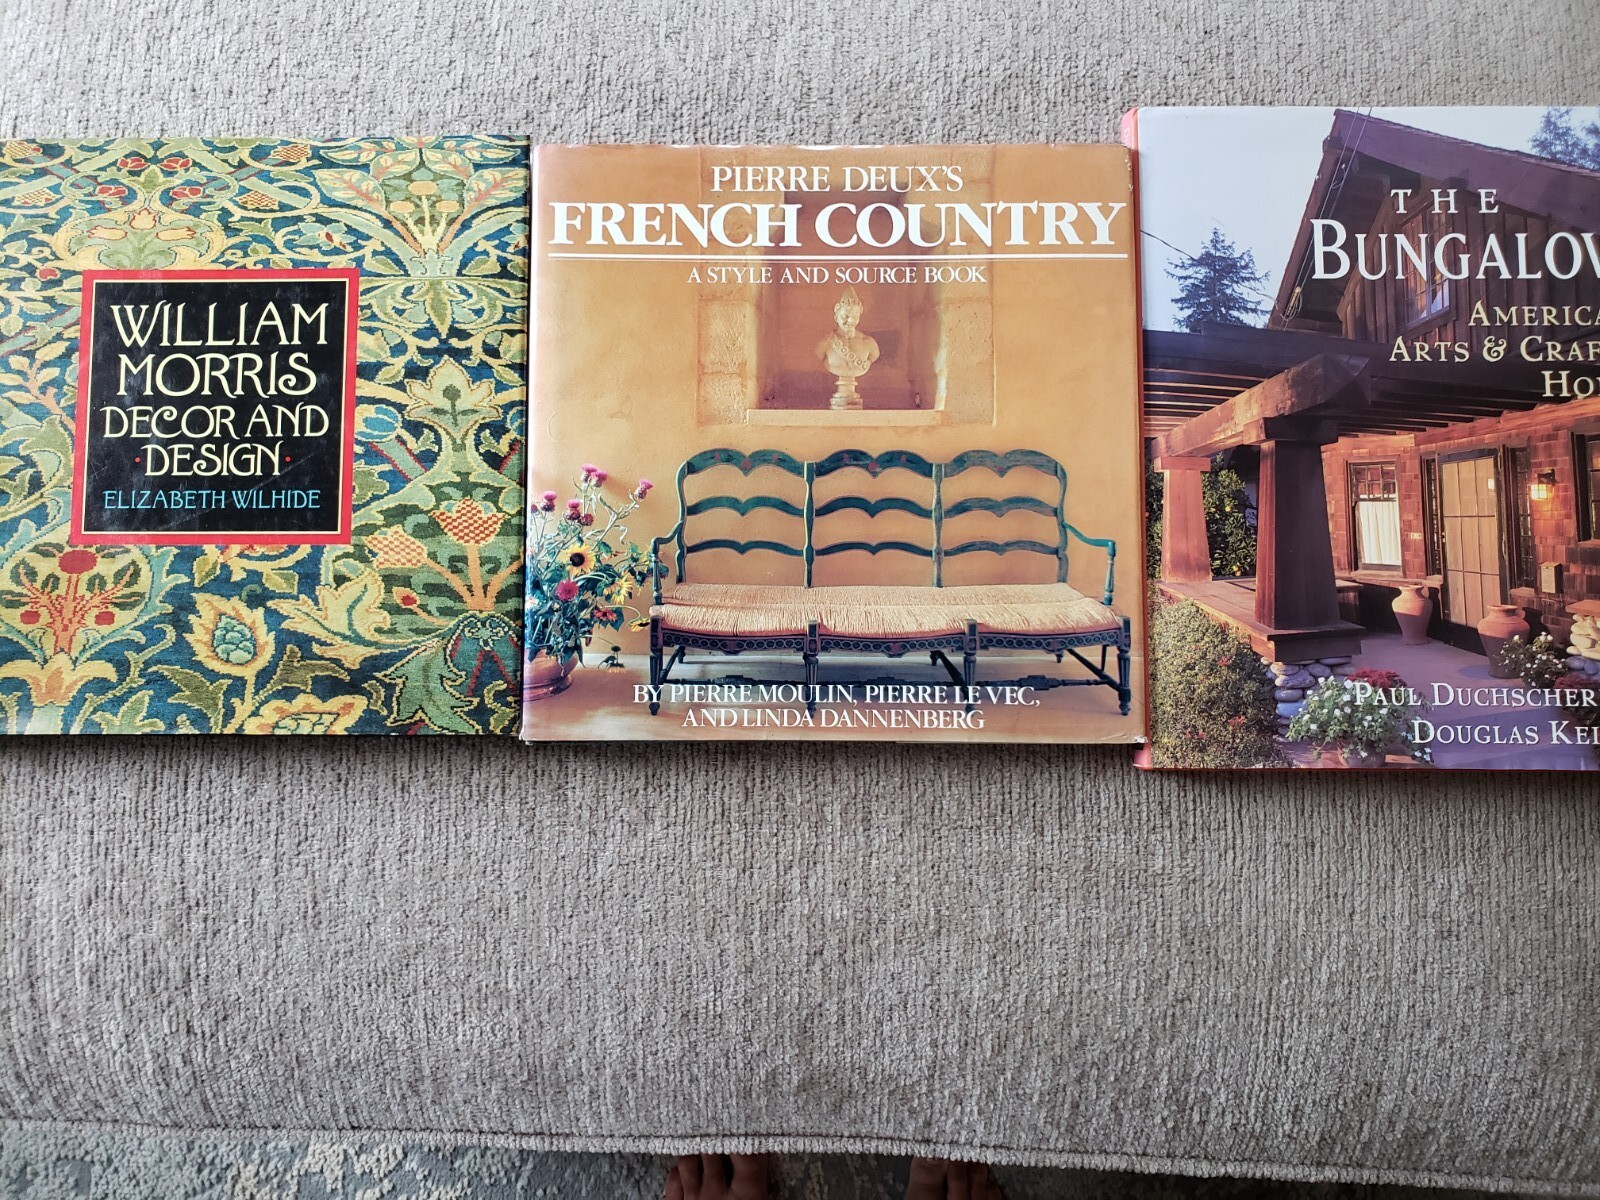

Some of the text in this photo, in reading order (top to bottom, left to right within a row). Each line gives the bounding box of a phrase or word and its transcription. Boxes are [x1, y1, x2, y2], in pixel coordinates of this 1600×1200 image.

[711, 166, 831, 192] PIERRE
[1390, 188, 1499, 214] THE
[548, 200, 1127, 248] FRENCH COUNTRY
[687, 266, 987, 284] A STYLE AND SOURCE BOOK
[110, 300, 329, 348] WILLIAM
[1389, 336, 1470, 362] ARTS
[1482, 336, 1507, 362] &
[117, 351, 317, 398] MORRIS
[1541, 370, 1600, 398] HO
[100, 402, 329, 440] DECOR AND
[141, 441, 284, 476] DESIGN
[103, 490, 321, 509] ELIZABETH WILHIDE
[633, 684, 1041, 707] BY PIERRE MOULIN, PIERRE LE VEC,
[1353, 682, 1600, 707] PAUL DUCHSCHER
[682, 708, 986, 729] AND LINDA DANNENBERG
[1411, 720, 1539, 745] DOUGLAS
